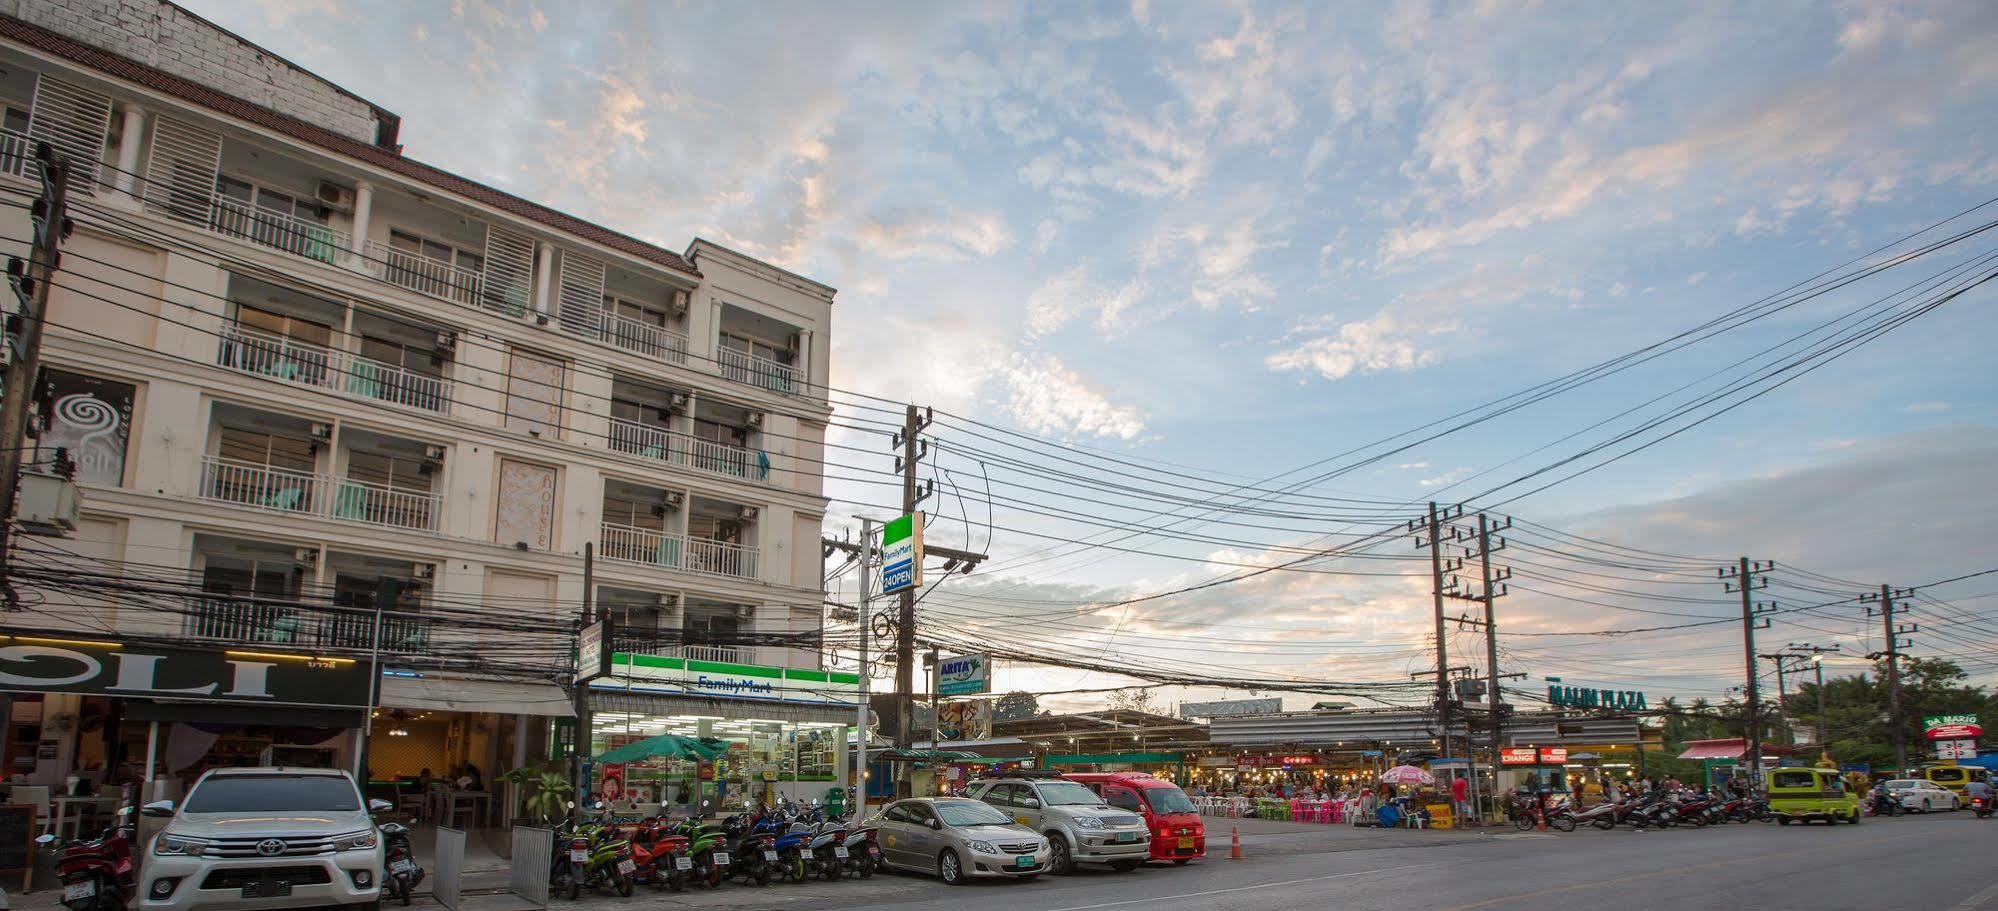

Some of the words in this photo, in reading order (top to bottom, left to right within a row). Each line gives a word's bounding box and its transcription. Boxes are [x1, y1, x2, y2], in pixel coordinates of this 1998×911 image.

[883, 544, 912, 560] FamilyMart
[698, 675, 772, 694] FamilyMart
[1548, 685, 1598, 706] MALIN
[1601, 689, 1647, 711] PLAZA
[1944, 715, 1976, 724] MARIO
